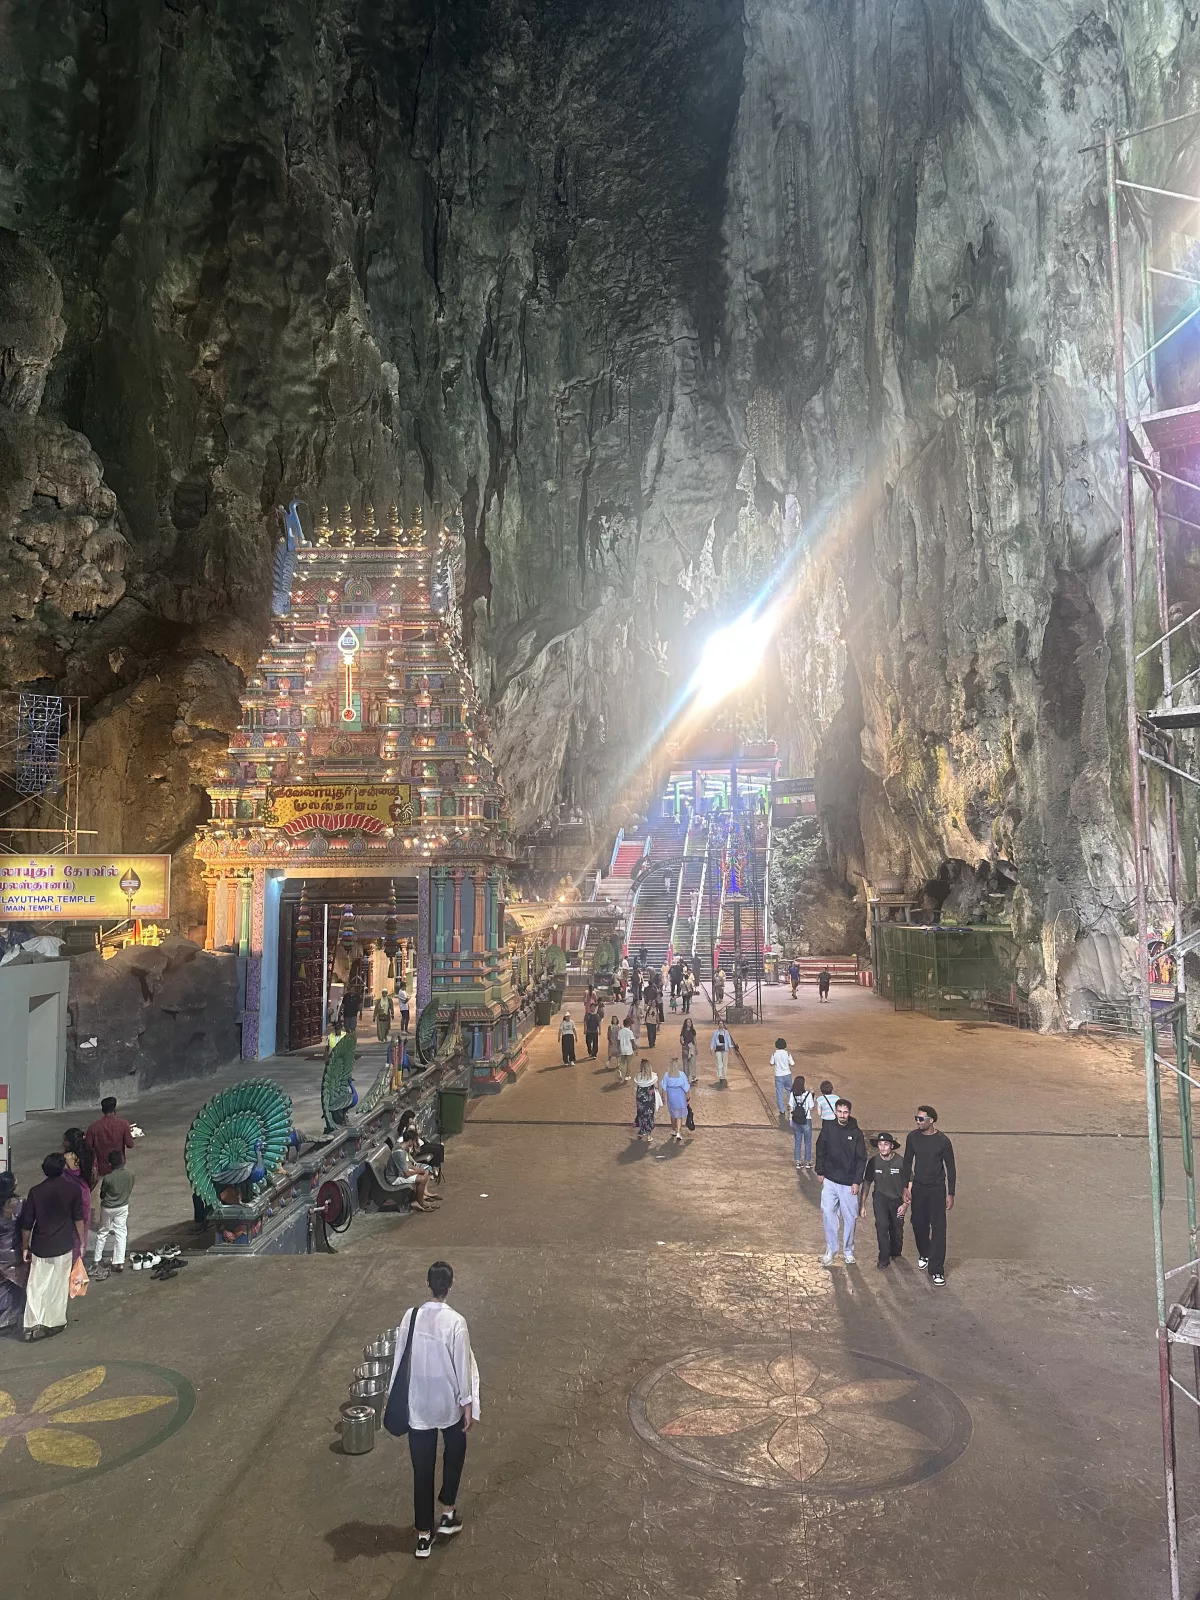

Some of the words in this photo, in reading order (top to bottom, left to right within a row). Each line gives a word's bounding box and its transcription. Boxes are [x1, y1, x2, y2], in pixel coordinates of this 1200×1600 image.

[63, 864, 119, 877] கோவில்
[0, 895, 54, 904] LAYUTHAR
[57, 895, 96, 903] TEMPLE
